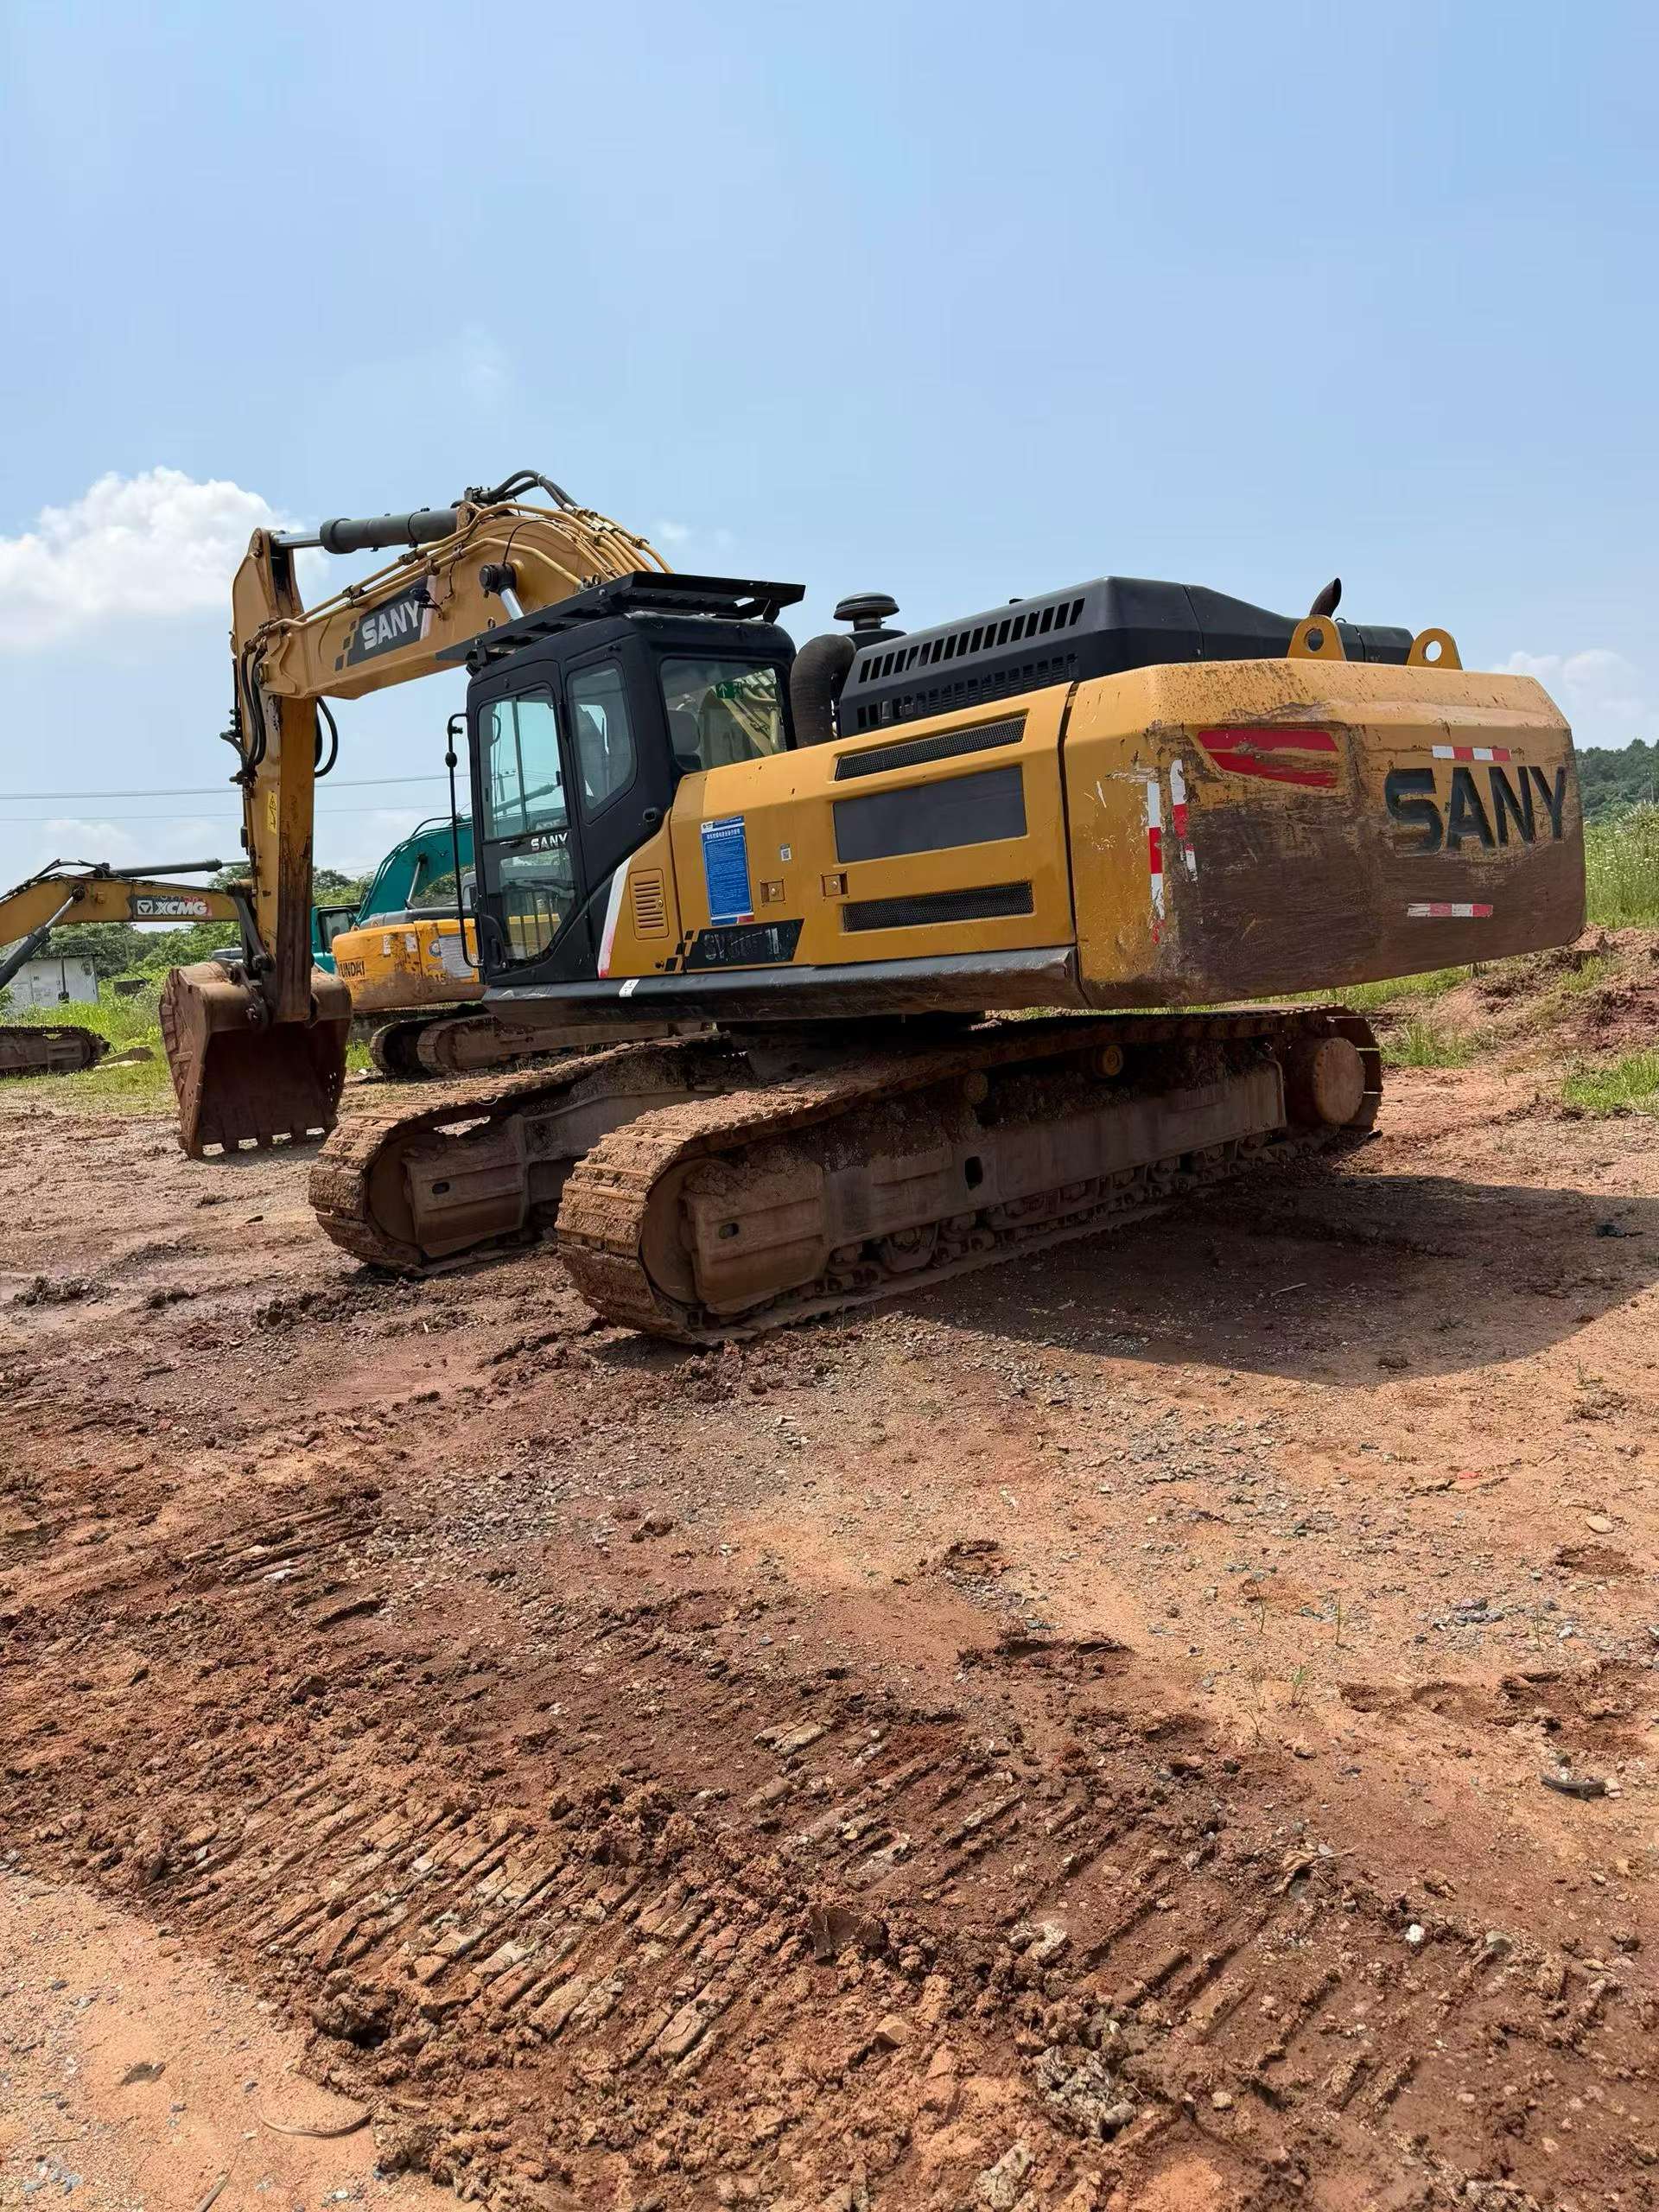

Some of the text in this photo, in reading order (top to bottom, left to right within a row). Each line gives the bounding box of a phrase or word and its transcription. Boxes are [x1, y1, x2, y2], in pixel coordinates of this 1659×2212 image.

[362, 601, 419, 650] SANY
[1384, 766, 1567, 856] SANY
[531, 832, 568, 851] SANY
[156, 901, 207, 915] XCMG
[339, 961, 365, 978] UNDAI
